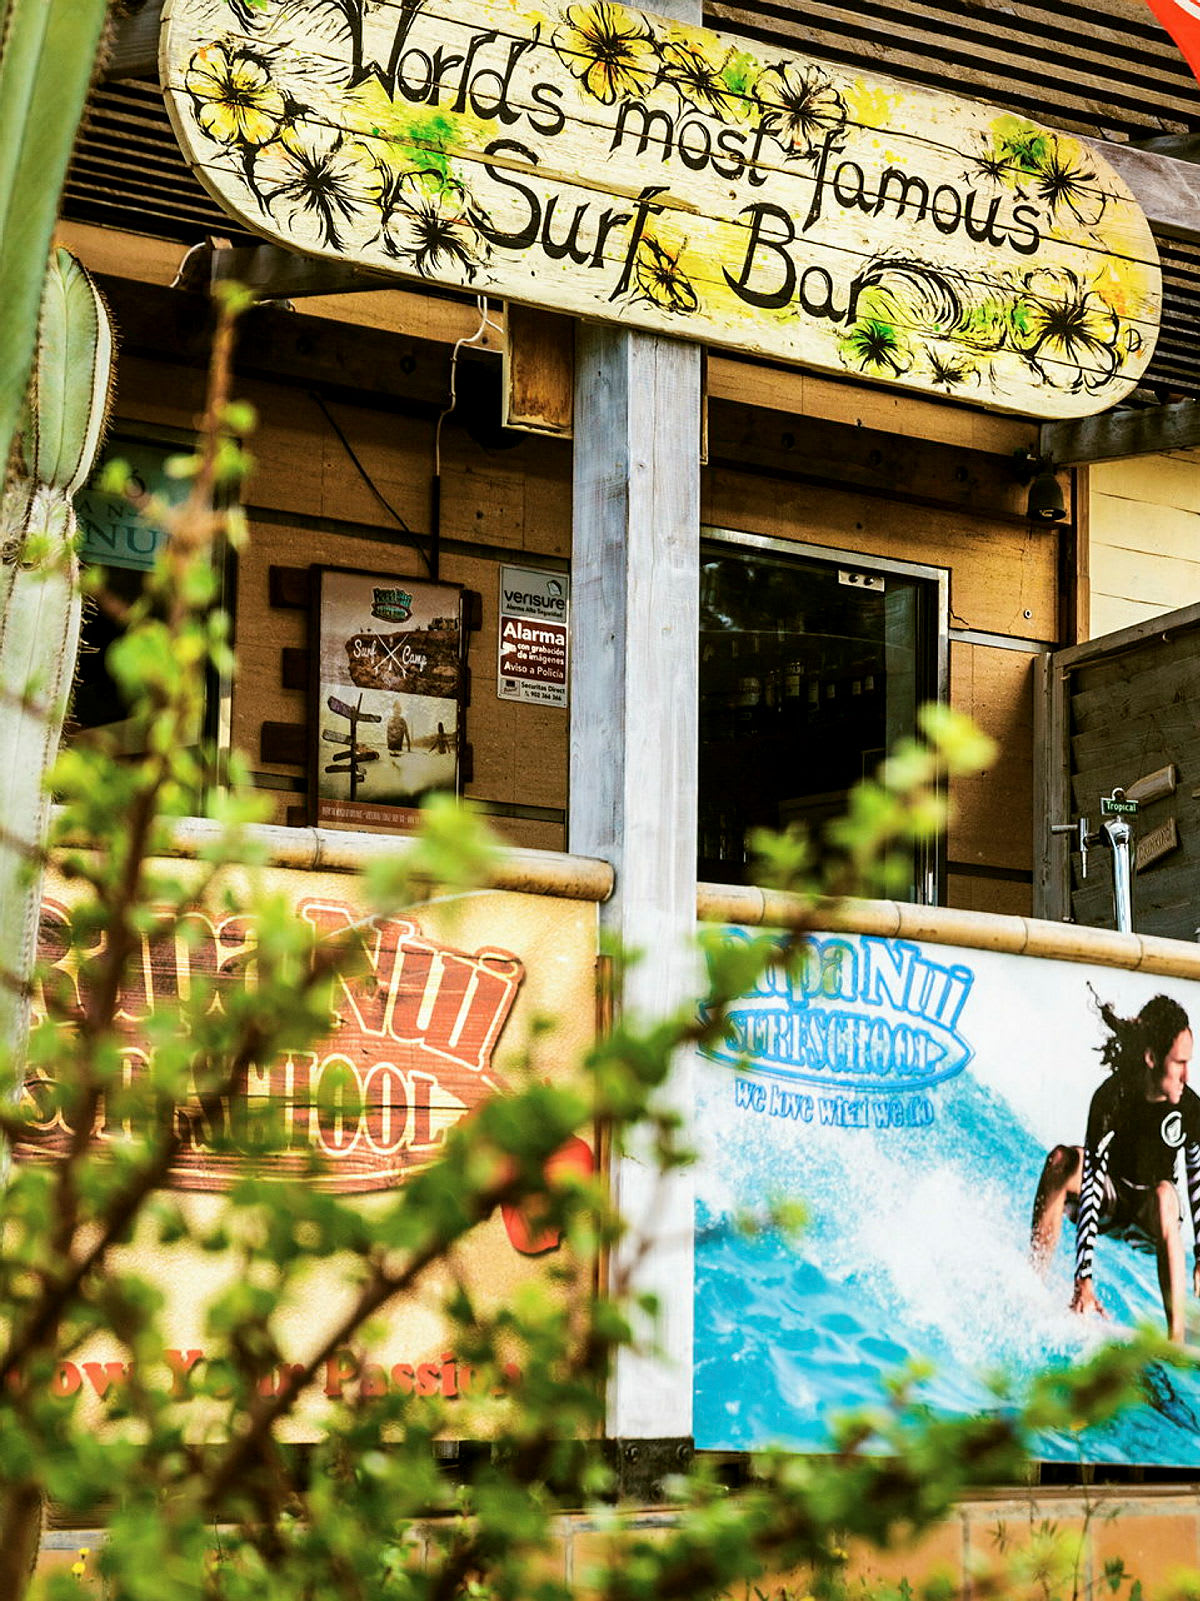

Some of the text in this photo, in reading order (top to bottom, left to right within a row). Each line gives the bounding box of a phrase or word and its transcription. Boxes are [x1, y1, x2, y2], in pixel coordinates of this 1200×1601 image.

[346, 0, 1042, 256] World's most famous
[468, 139, 882, 327] Surf Bar
[504, 590, 565, 610] verisure
[503, 622, 565, 646] Alarma
[353, 639, 427, 672] Surf Camp
[517, 643, 530, 652] con
[517, 650, 528, 660] de
[504, 661, 528, 673] Aviso
[1106, 801, 1137, 812] Tropical
[858, 934, 975, 1030] Nui
